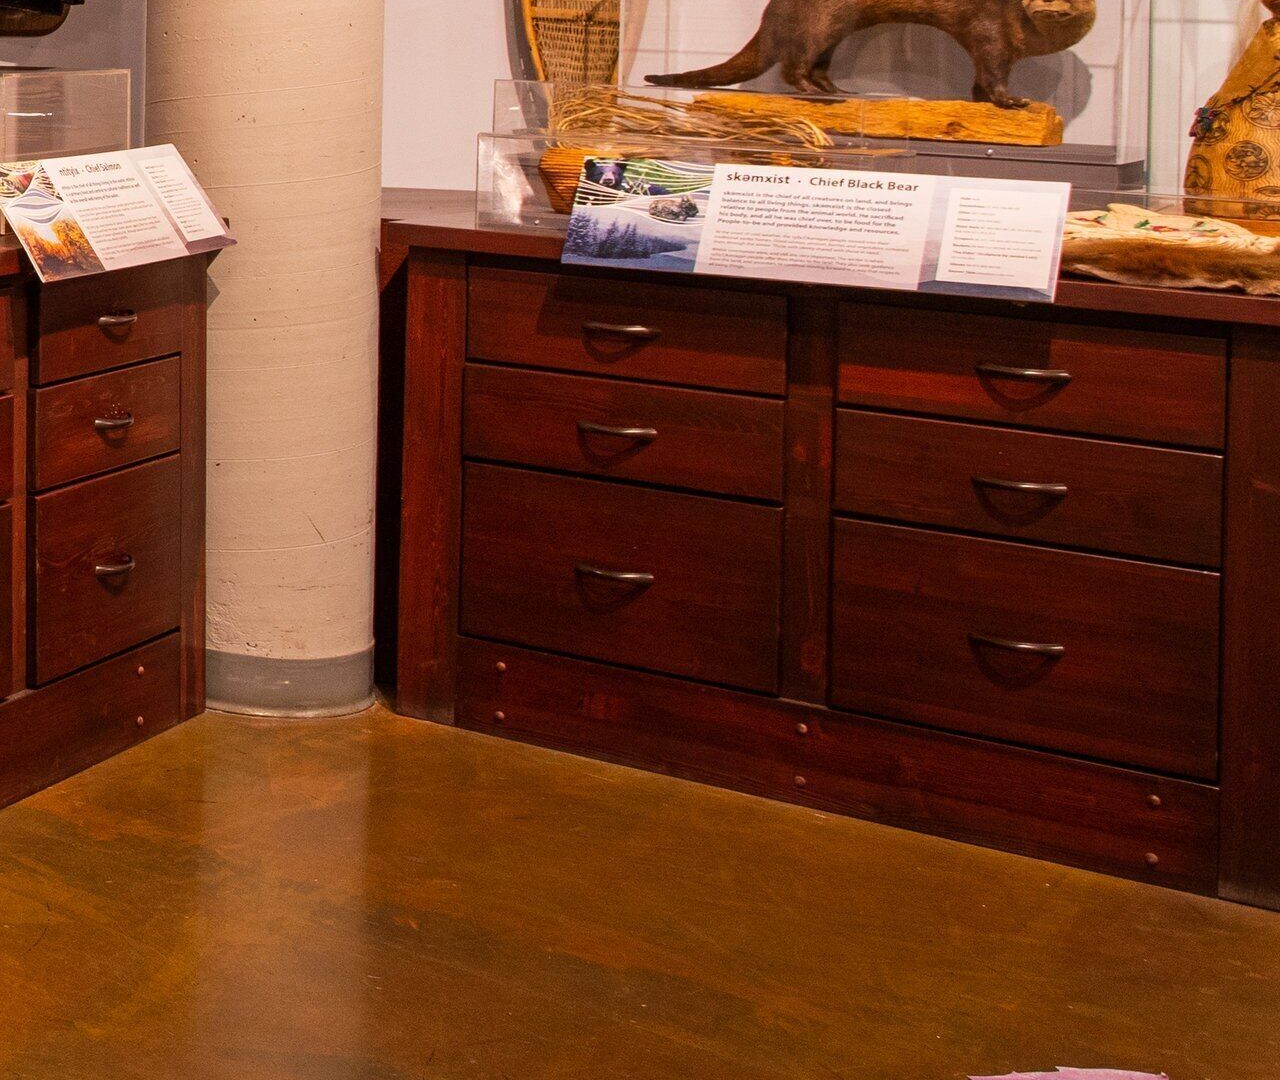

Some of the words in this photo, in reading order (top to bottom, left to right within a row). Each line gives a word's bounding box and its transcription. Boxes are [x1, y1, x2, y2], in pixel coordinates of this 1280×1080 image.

[85, 163, 102, 173] Chief
[99, 162, 122, 171] Salmon
[810, 177, 845, 187] Chief
[848, 179, 884, 189] Black
[887, 182, 919, 192] Bear
